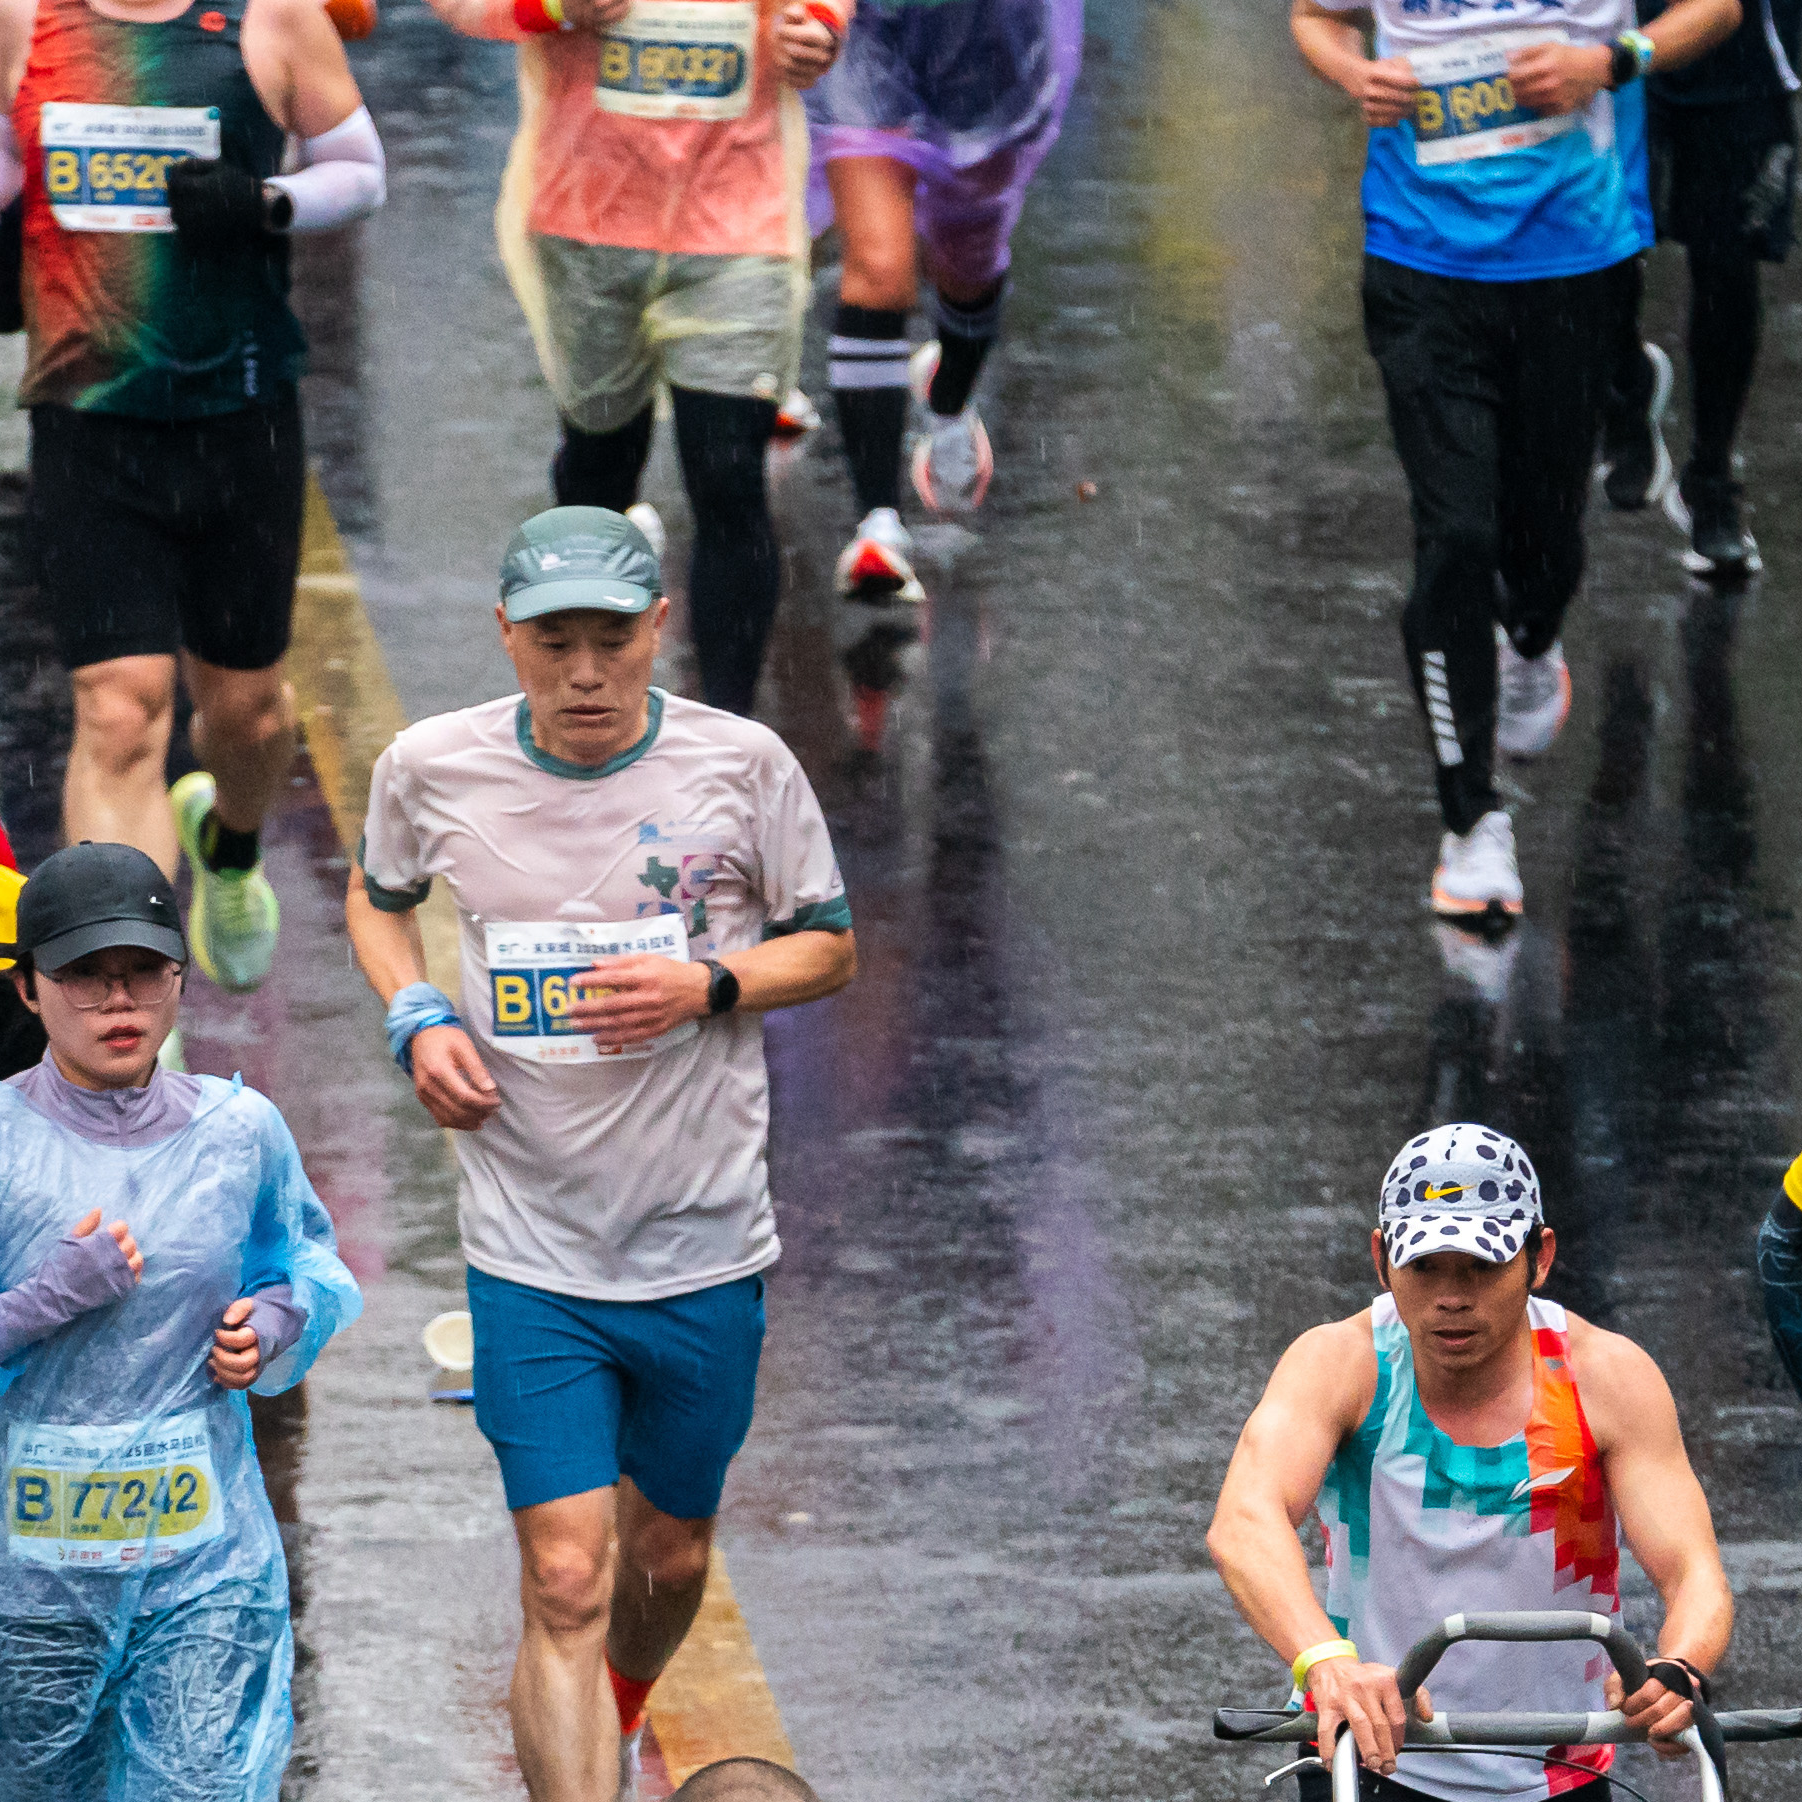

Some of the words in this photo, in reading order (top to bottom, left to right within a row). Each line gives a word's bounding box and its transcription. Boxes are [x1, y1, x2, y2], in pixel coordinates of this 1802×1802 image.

[603, 41, 630, 82] B
[1415, 89, 1445, 131] B
[1450, 77, 1516, 120] 600
[48, 150, 80, 193] B
[88, 152, 186, 191] 6520
[495, 974, 532, 1024] B
[16, 1475, 53, 1522] B
[69, 1472, 198, 1521] 77242
